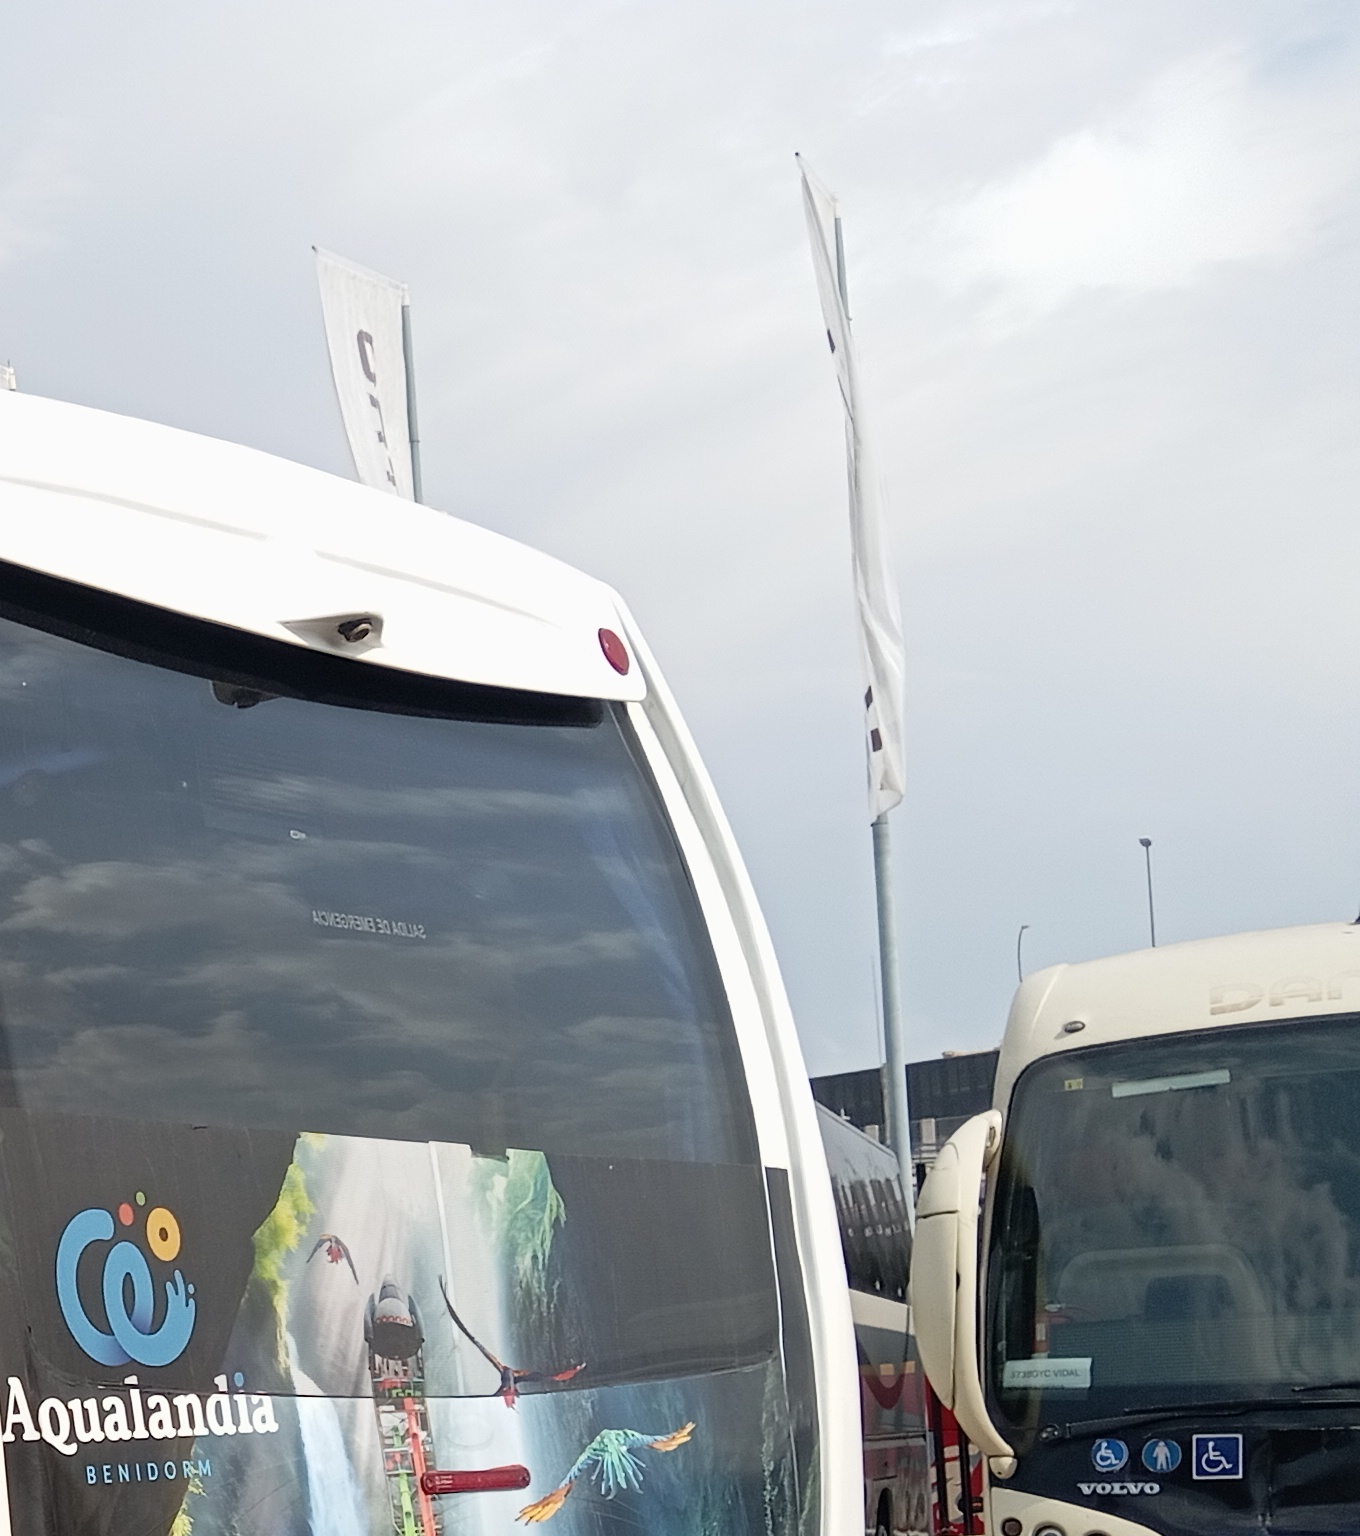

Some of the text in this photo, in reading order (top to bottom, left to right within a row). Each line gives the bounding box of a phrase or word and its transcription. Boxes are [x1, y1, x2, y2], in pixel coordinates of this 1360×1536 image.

[1052, 1368, 1081, 1378] VIDAL
[1, 1371, 279, 1456] Aqualandia
[85, 1457, 214, 1486] BENIDORM
[1076, 1482, 1161, 1496] VOLVO
